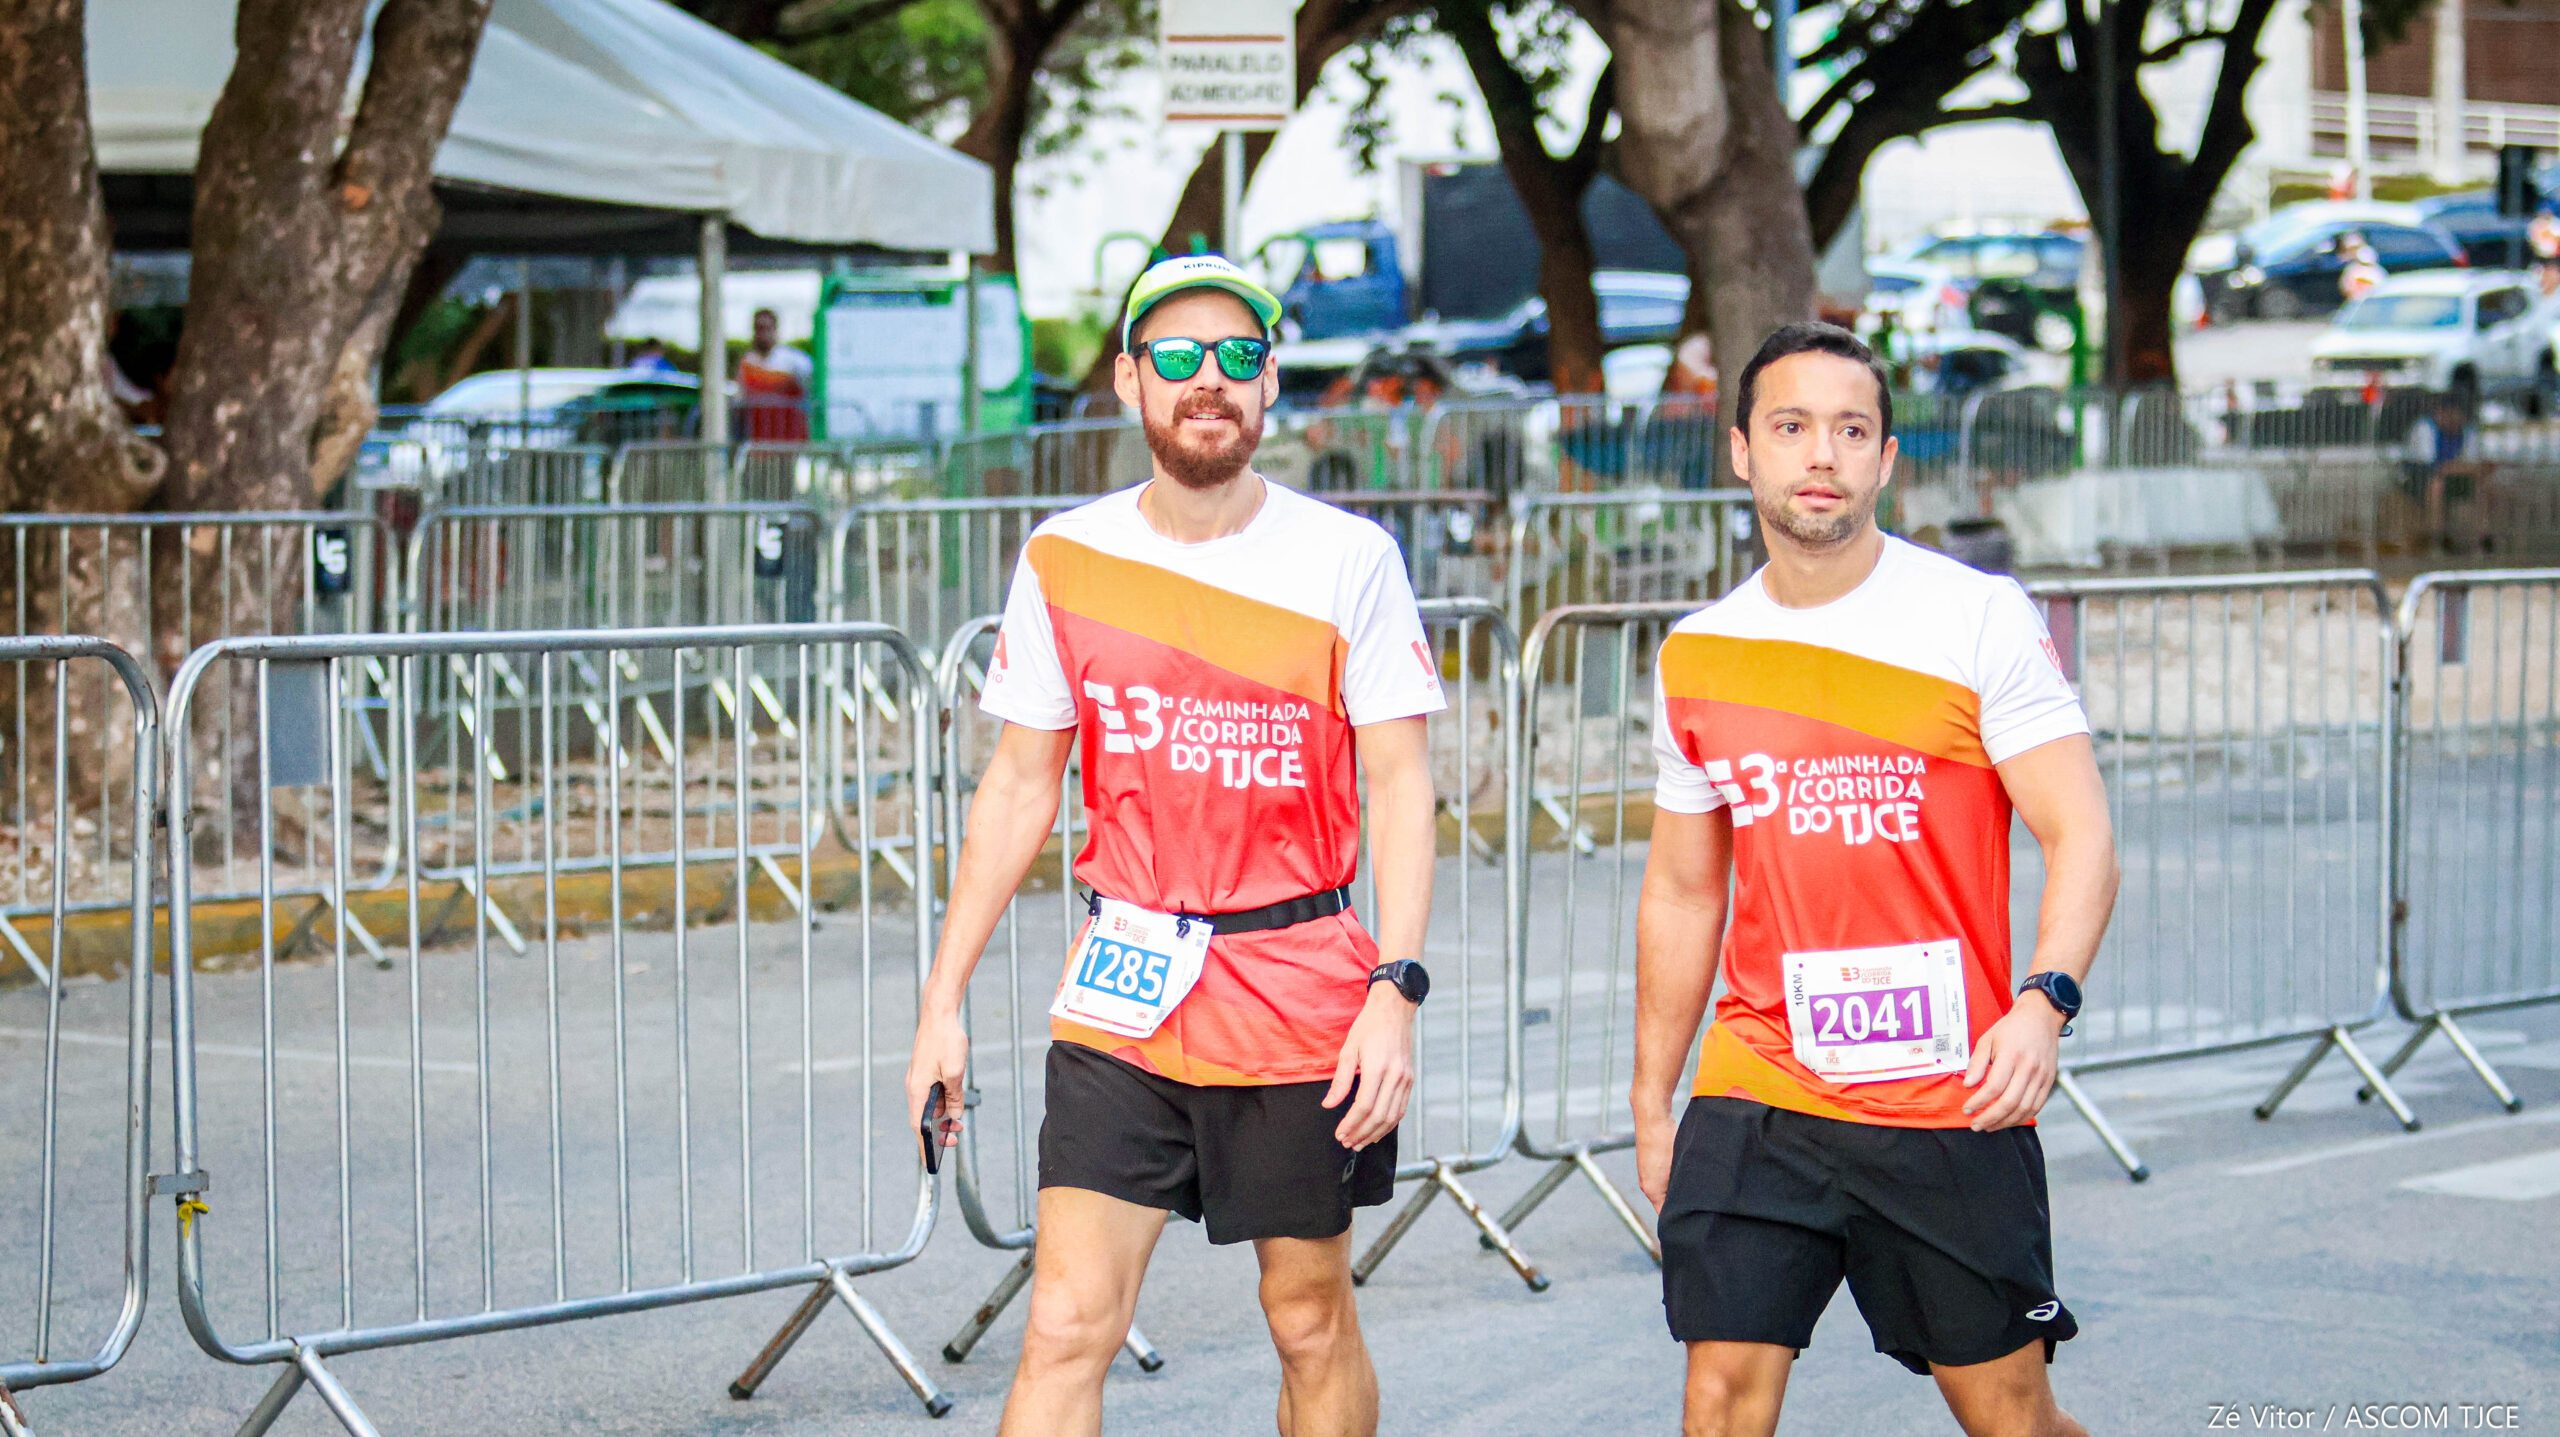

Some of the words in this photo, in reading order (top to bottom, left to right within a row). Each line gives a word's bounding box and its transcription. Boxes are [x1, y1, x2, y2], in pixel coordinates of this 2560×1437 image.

[1179, 696, 1311, 722] CAMINHADA
[1170, 720, 1303, 747] /CORRIDA
[1170, 744, 1211, 773] DO
[1215, 746, 1306, 790] TJCE
[1793, 755, 1927, 779] CAMINHADA
[1787, 777, 1926, 805] /CORRIDA
[1788, 806, 1832, 835] DO
[1835, 802, 1920, 846] TJCE
[1083, 940, 1167, 1001] 1285
[1792, 973, 1805, 1008] 10KM
[1812, 989, 1925, 1042] 2041
